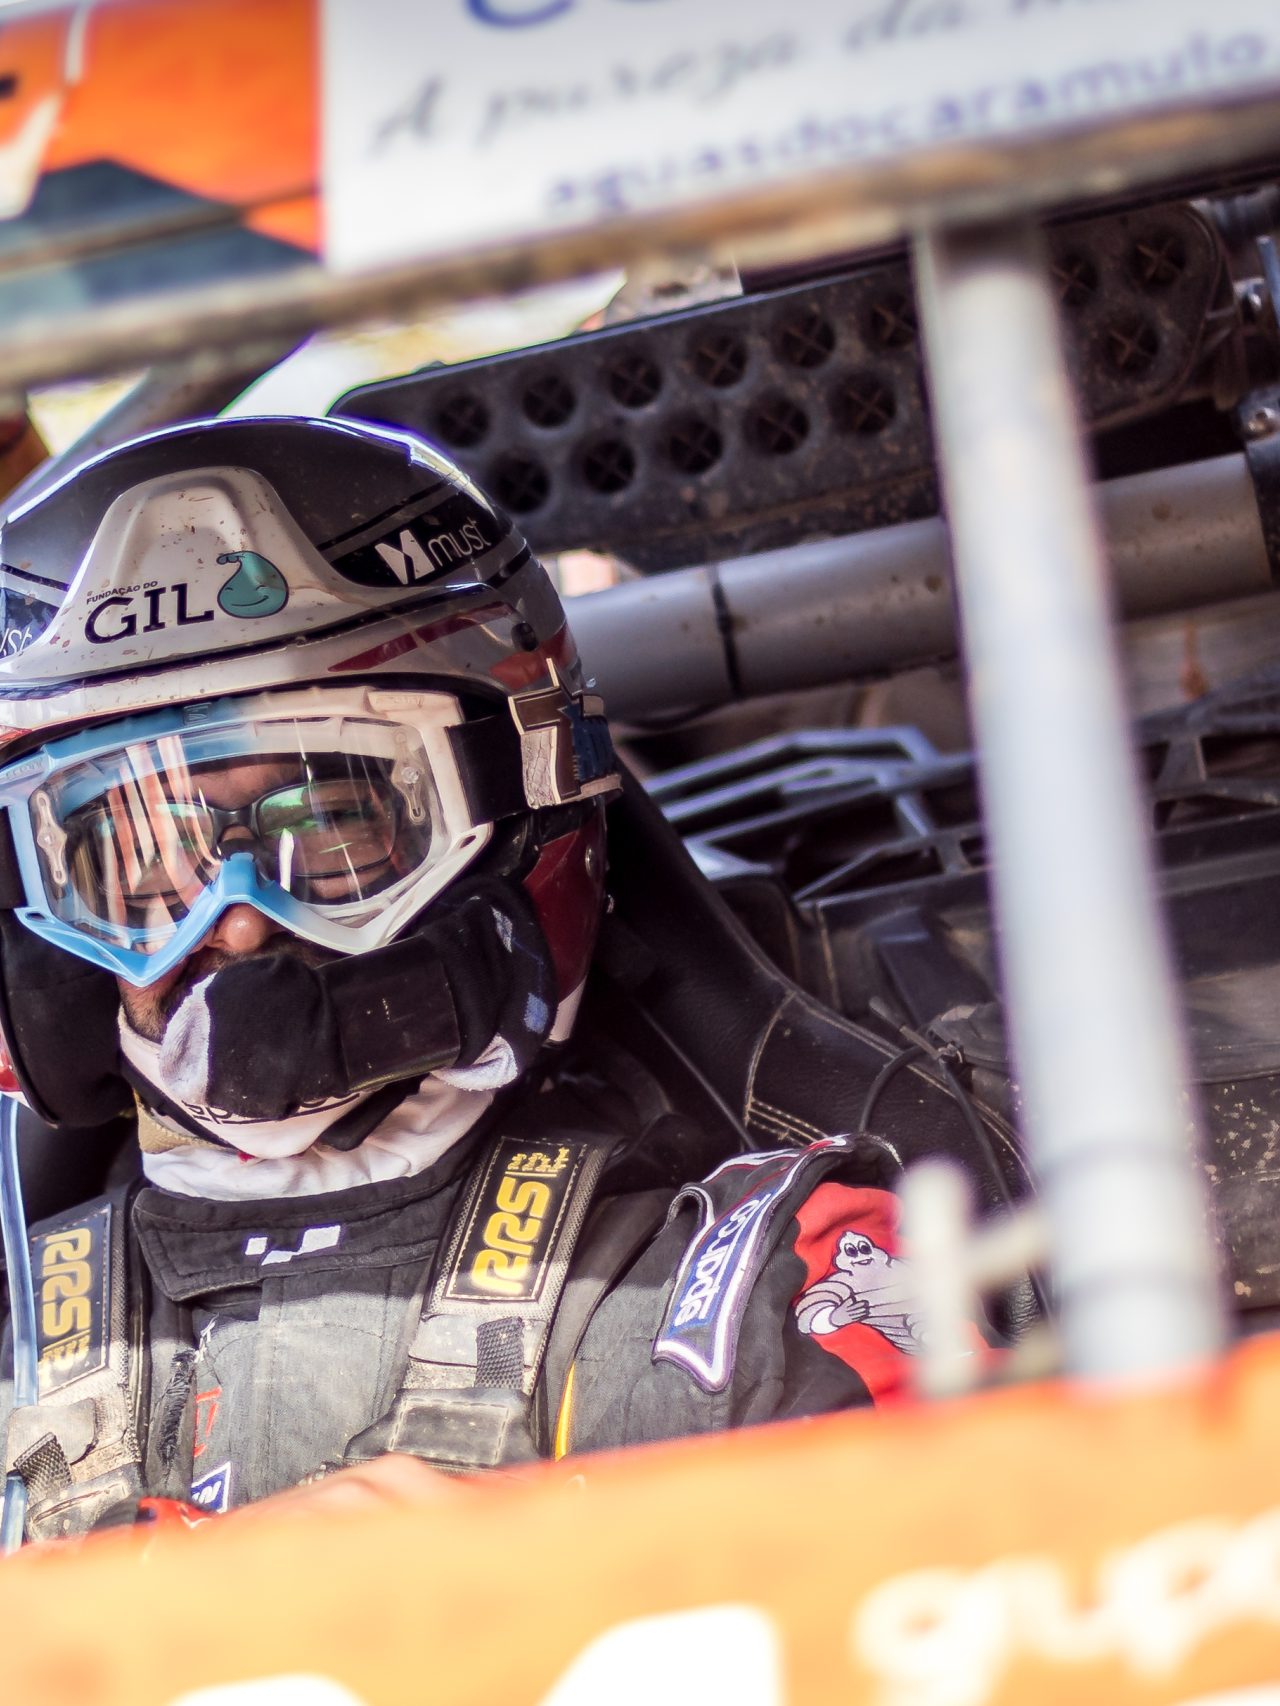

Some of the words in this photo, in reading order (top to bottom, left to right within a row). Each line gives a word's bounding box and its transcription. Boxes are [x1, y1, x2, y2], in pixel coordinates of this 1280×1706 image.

[427, 516, 492, 567] must
[84, 582, 215, 645] GIL
[142, 580, 159, 590] DO
[471, 1176, 551, 1295] RRS
[42, 1227, 92, 1338] RRS
